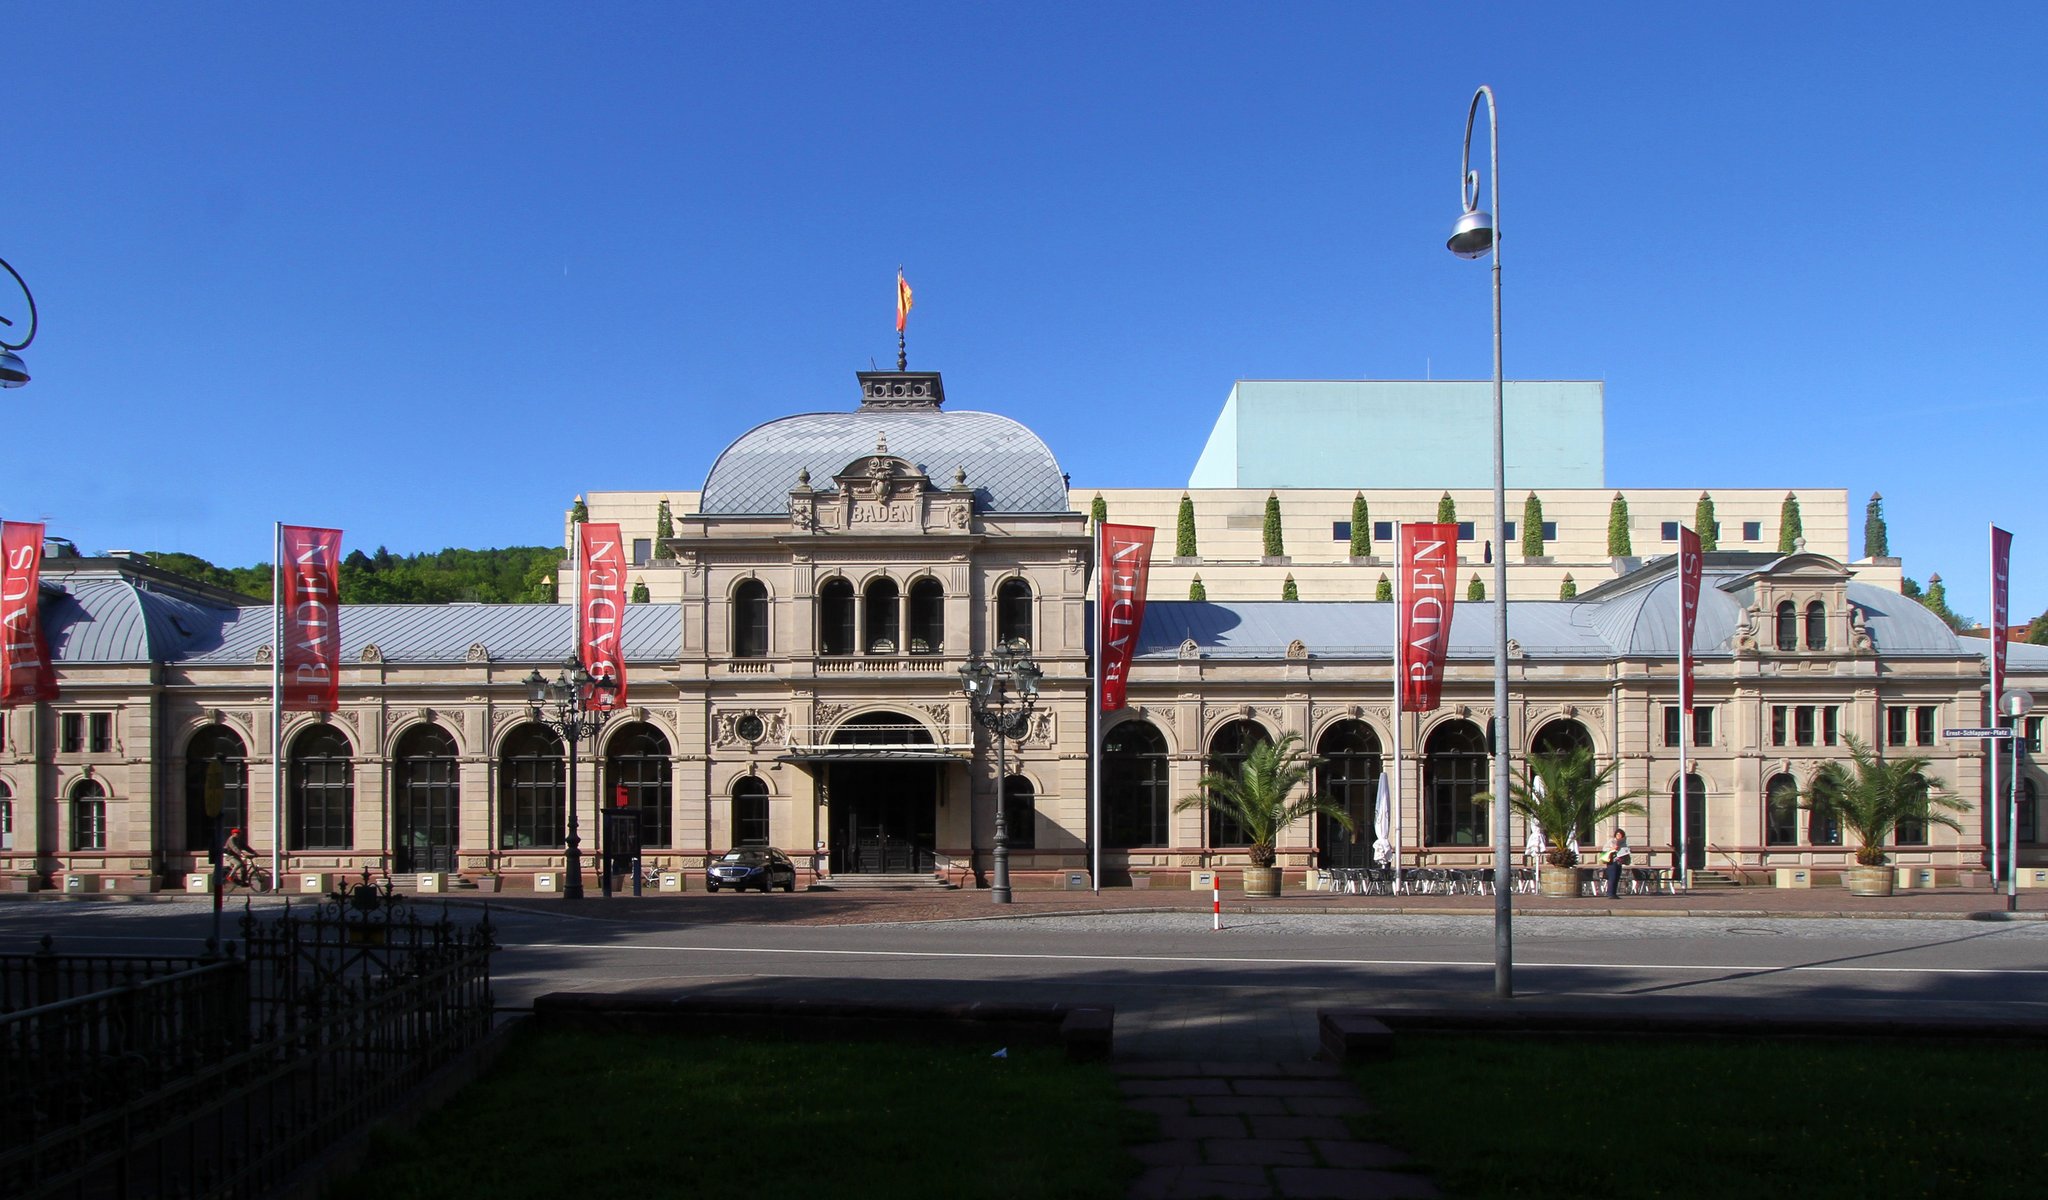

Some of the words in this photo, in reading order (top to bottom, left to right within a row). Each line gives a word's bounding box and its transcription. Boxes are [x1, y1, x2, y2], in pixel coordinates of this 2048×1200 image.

[851, 504, 914, 523] BADEN
[3, 545, 43, 670] HAUS
[296, 540, 331, 686] BADEN
[588, 537, 618, 682] BADEN
[1105, 536, 1144, 686] BADEN
[1411, 537, 1447, 682] BADEN
[1946, 729, 2008, 737] Ernst-Schlapper-Platz
